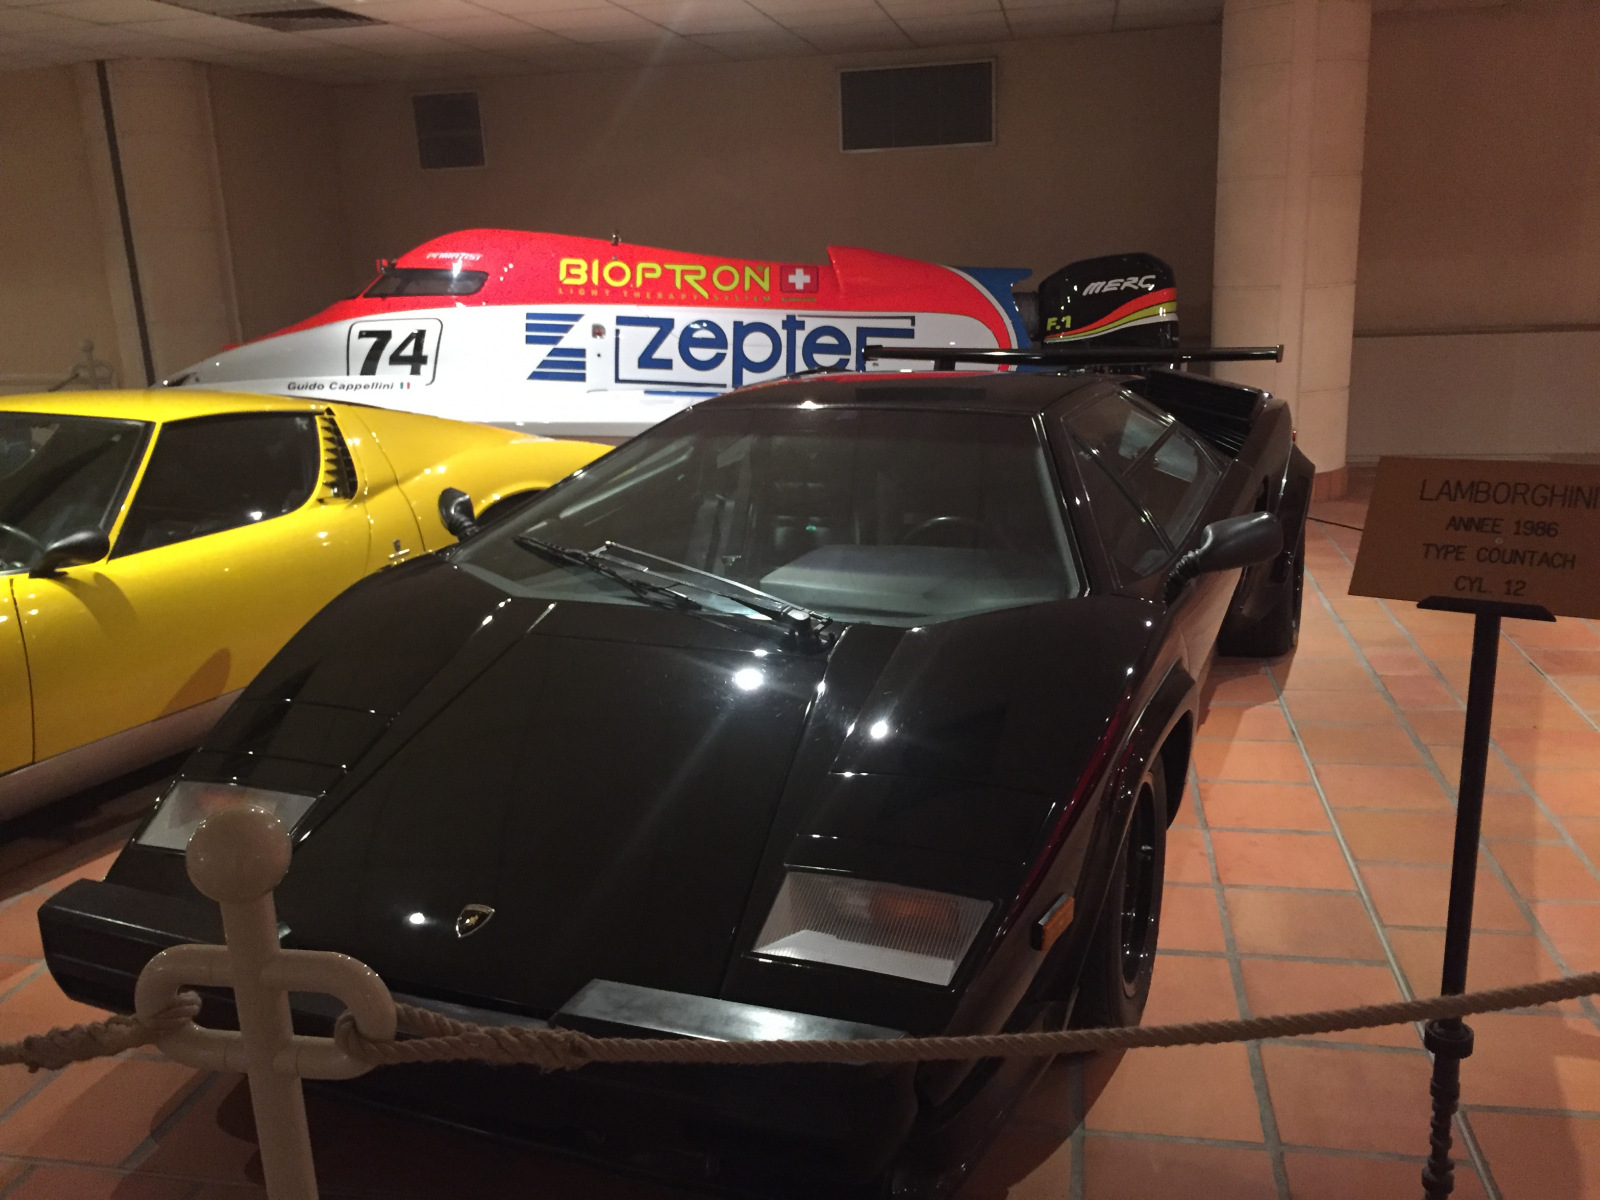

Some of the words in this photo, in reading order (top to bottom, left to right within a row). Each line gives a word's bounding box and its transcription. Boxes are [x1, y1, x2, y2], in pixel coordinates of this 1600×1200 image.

[559, 257, 770, 299] BIOPTRON
[1082, 275, 1156, 296] MERC
[358, 329, 428, 376] 74
[287, 382, 325, 391] Guido
[329, 382, 394, 392] Cappellini
[1419, 479, 1600, 509] LAMBORGHINI
[1446, 516, 1504, 534] ANNEE
[1513, 520, 1559, 537] 1986
[1423, 543, 1467, 562] TYPE
[1476, 547, 1576, 569] COUNTACH
[1504, 580, 1527, 597] 12
